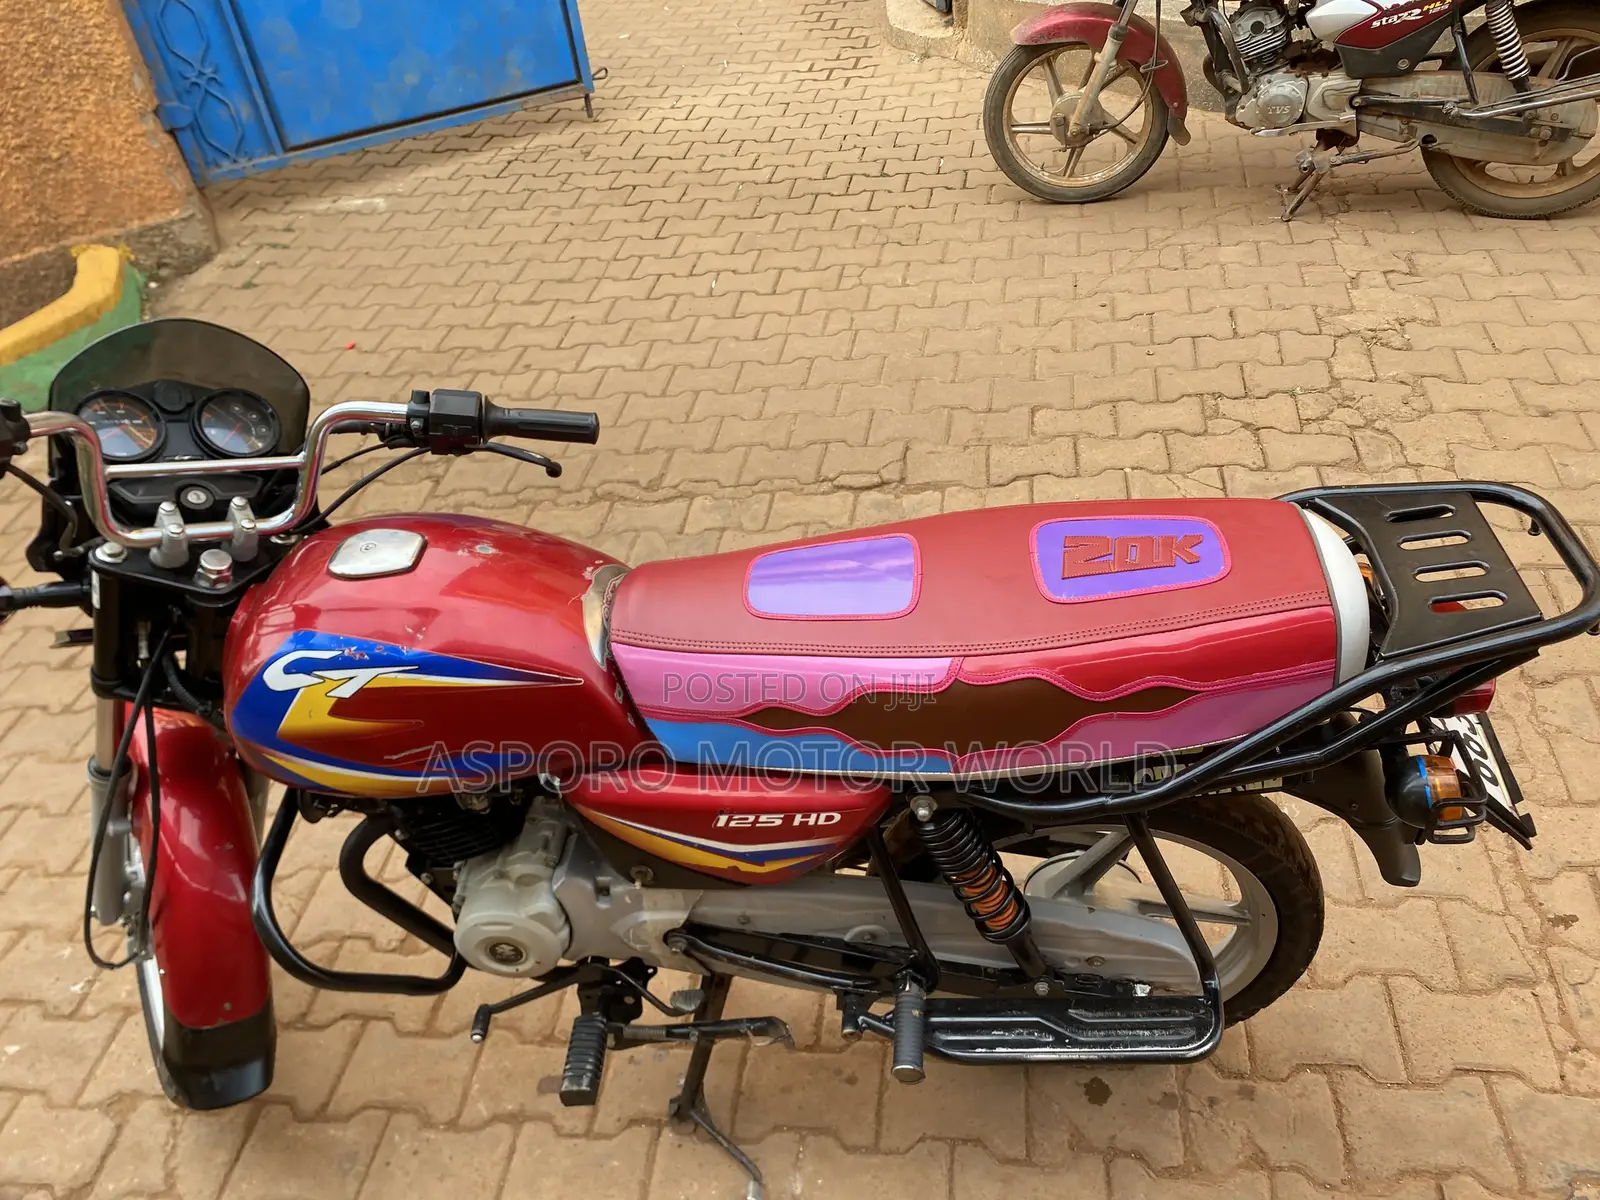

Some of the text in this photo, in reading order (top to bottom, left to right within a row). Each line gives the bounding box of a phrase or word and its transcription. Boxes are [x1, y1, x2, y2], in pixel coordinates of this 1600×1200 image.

[1267, 105, 1291, 115] TVS
[716, 812, 842, 827] 125 HD
